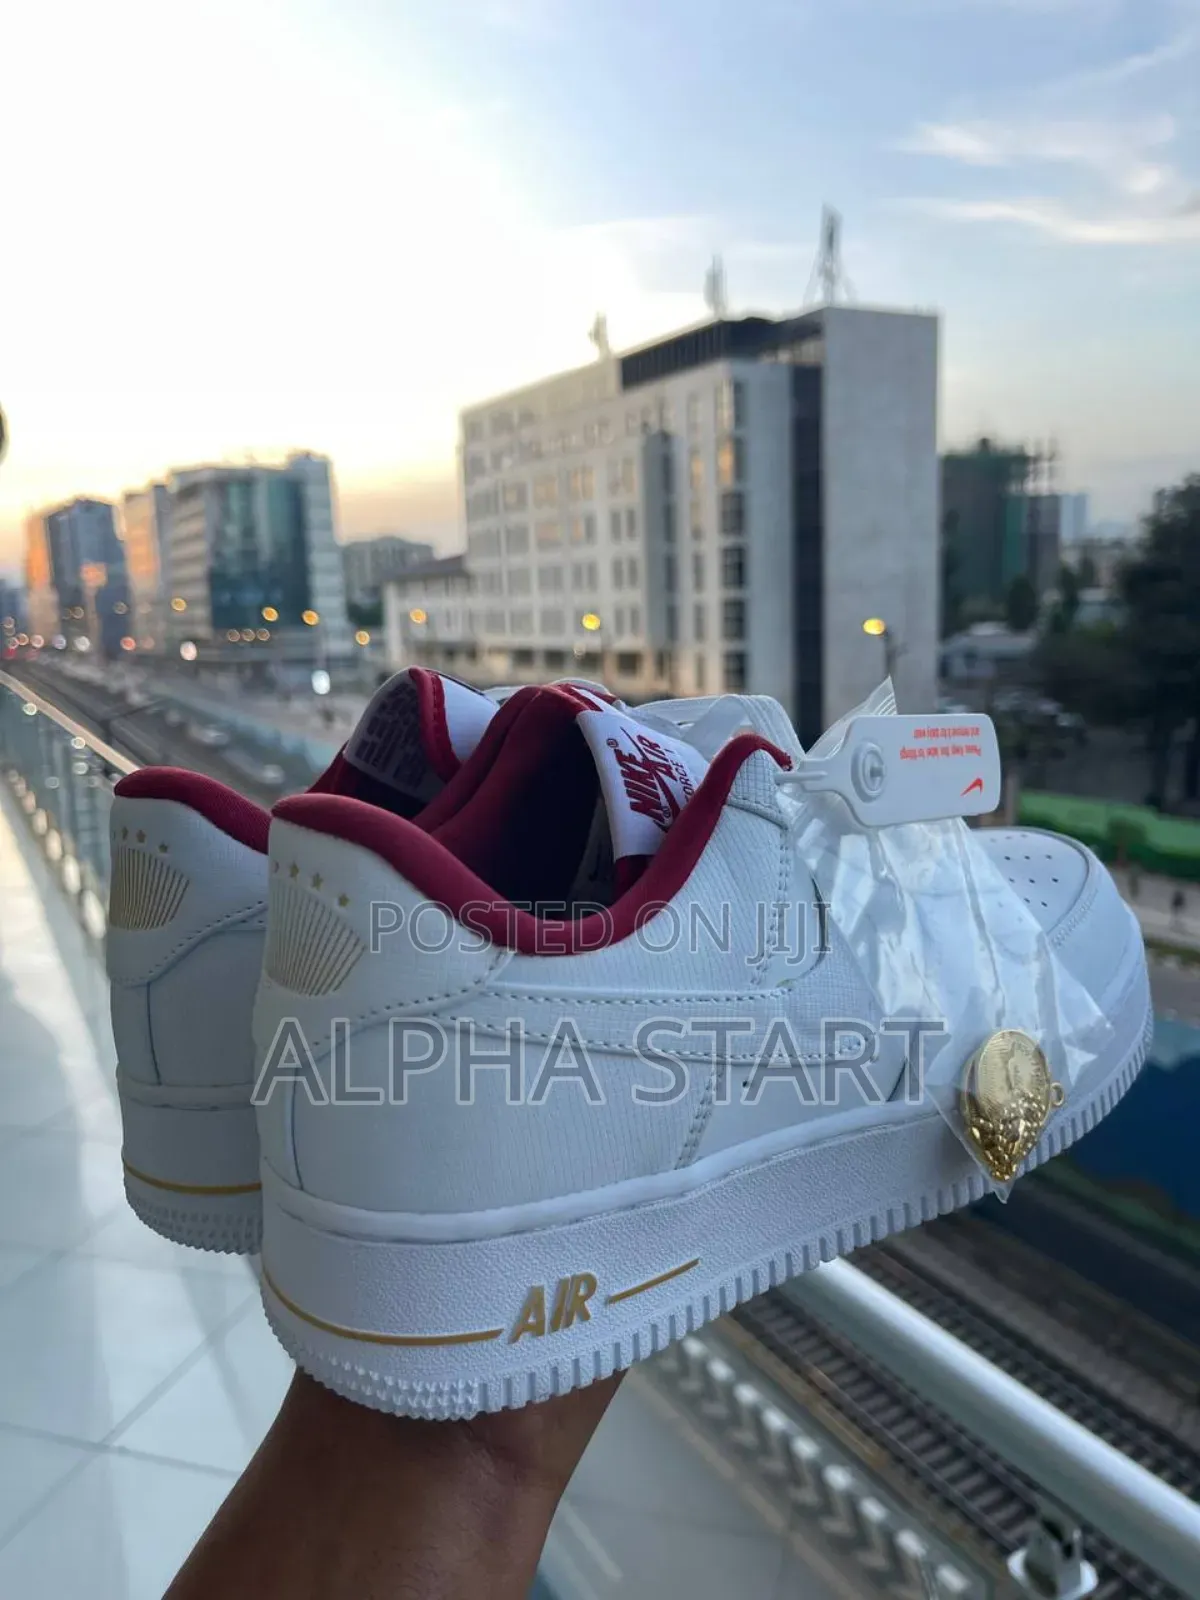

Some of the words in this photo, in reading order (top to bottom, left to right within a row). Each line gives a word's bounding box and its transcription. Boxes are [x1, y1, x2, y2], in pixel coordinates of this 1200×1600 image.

[613, 748, 666, 823] NIKE
[636, 734, 678, 782] AIR
[507, 1271, 598, 1344] AIR
